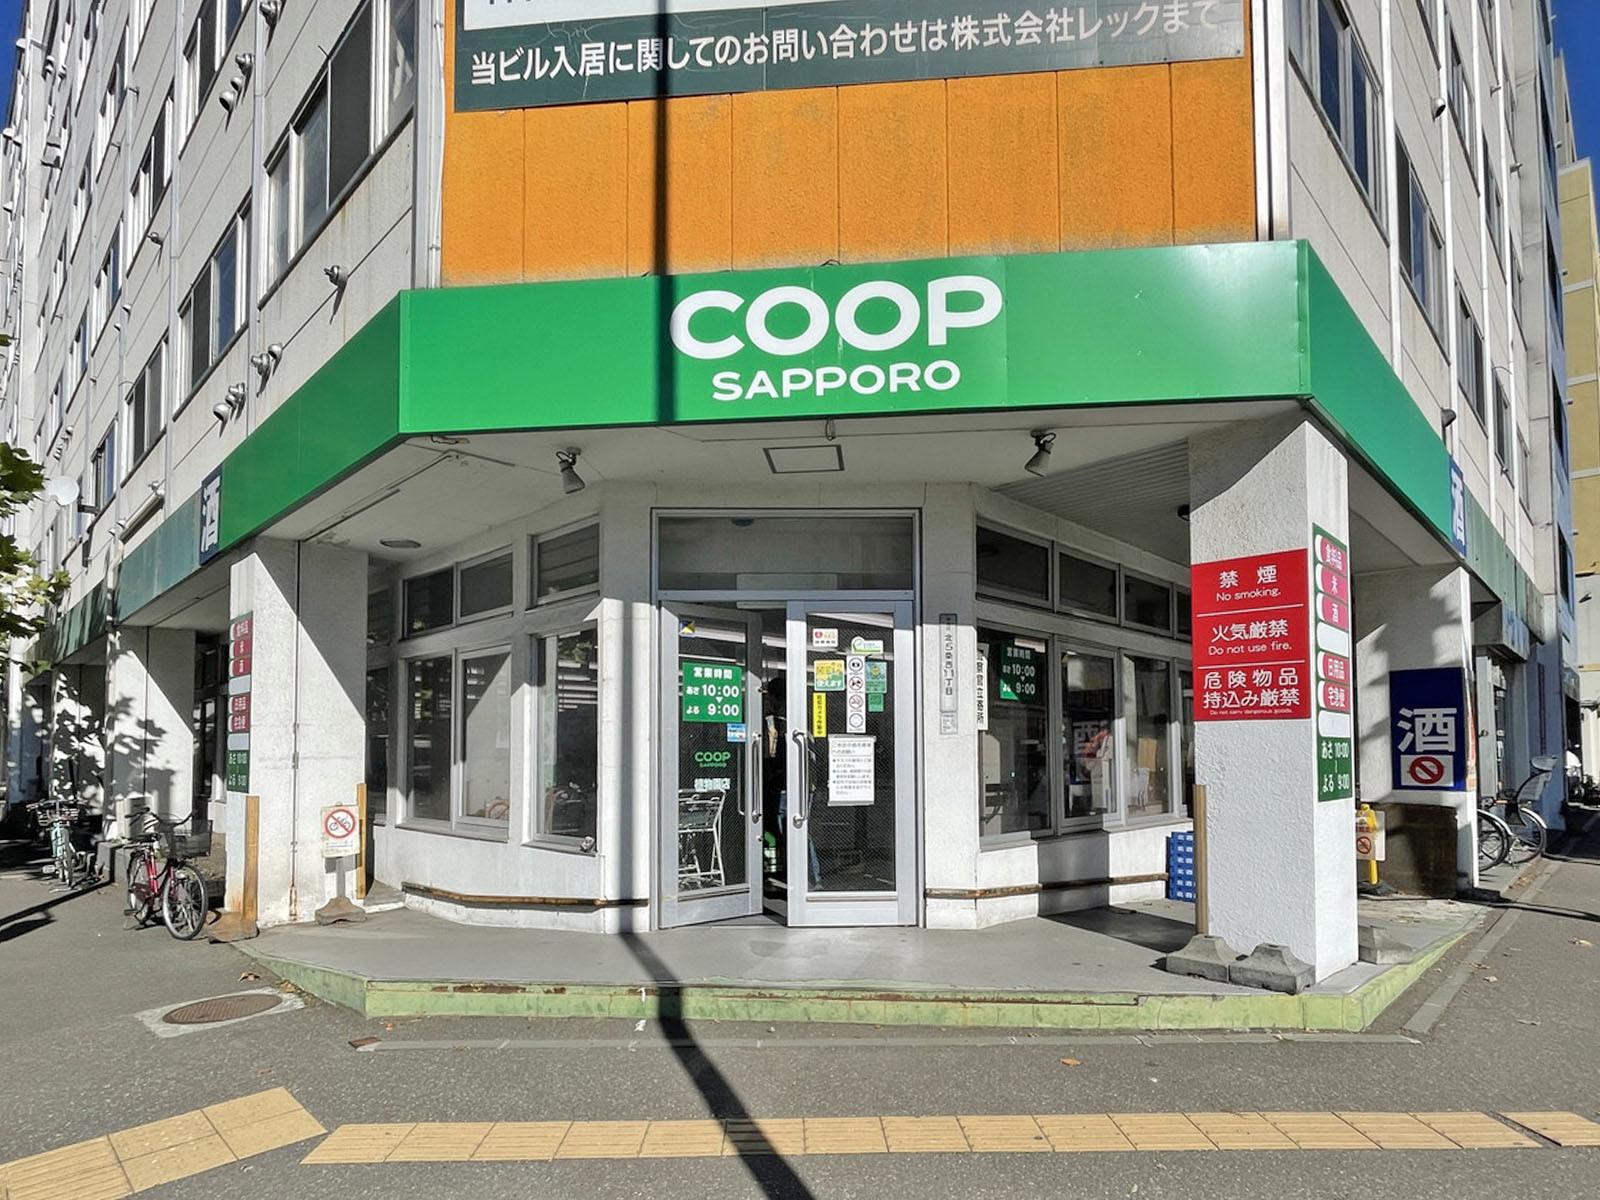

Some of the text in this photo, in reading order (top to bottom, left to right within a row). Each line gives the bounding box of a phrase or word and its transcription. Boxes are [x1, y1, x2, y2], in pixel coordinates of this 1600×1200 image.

[670, 276, 1002, 359] COOP
[712, 360, 960, 400] SAPPORO
[1219, 565, 1278, 589] 禁煙
[1216, 586, 1281, 602] No smoking.
[1211, 619, 1288, 643] 火気厳禁
[1208, 640, 1292, 656] Do not use fire.
[1012, 664, 1035, 677] 10:00
[1203, 667, 1298, 689] 危険物品
[686, 684, 739, 698] あさ 10:00
[1015, 682, 1035, 695] 9:00
[1203, 688, 1300, 709] 持込み厳禁
[686, 703, 739, 716] よる 9:00
[1397, 707, 1457, 753] 酒
[694, 751, 731, 762] COOP
